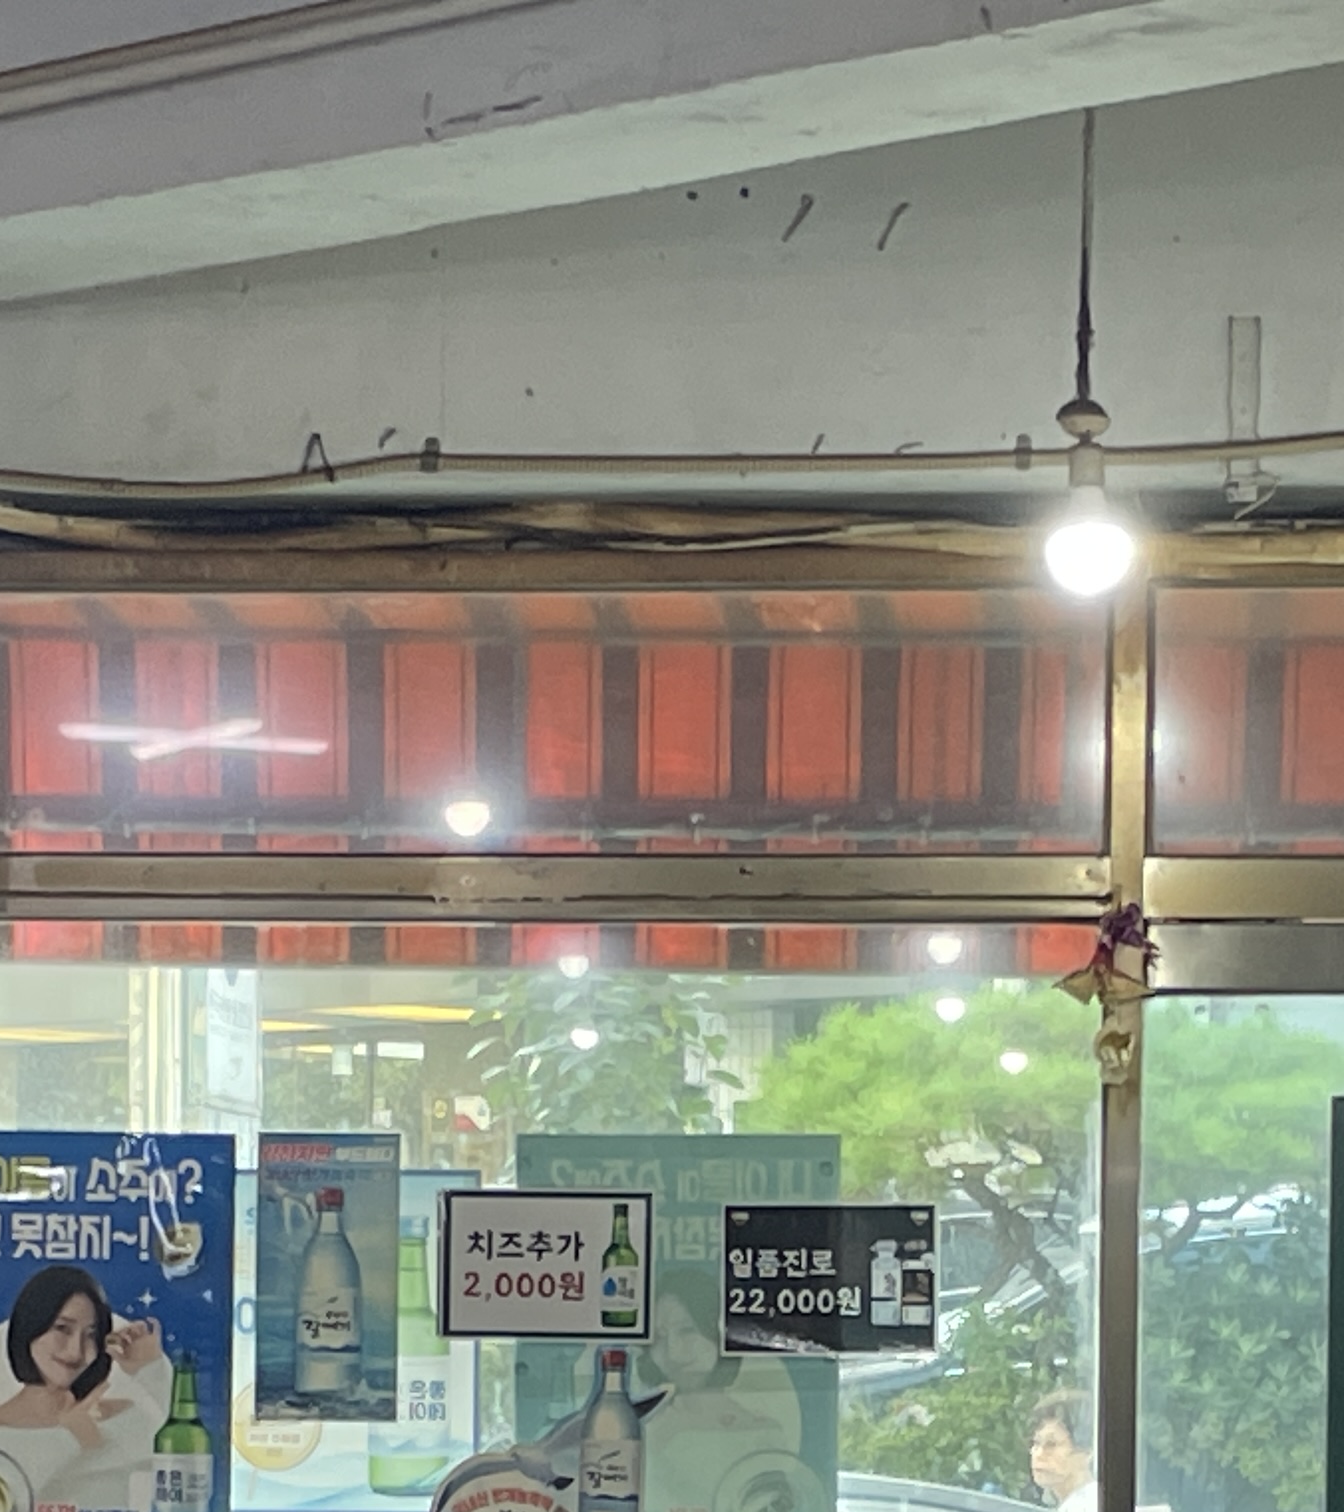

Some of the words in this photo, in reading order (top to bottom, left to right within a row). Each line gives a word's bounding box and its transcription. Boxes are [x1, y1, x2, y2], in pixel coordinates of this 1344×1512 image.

[10, 1211, 150, 1262] 못참지~!
[466, 1228, 586, 1262] 치즈추가
[728, 1247, 837, 1279] 일품진로
[462, 1270, 585, 1302] 2,000원
[729, 1285, 862, 1319] 22,000원
